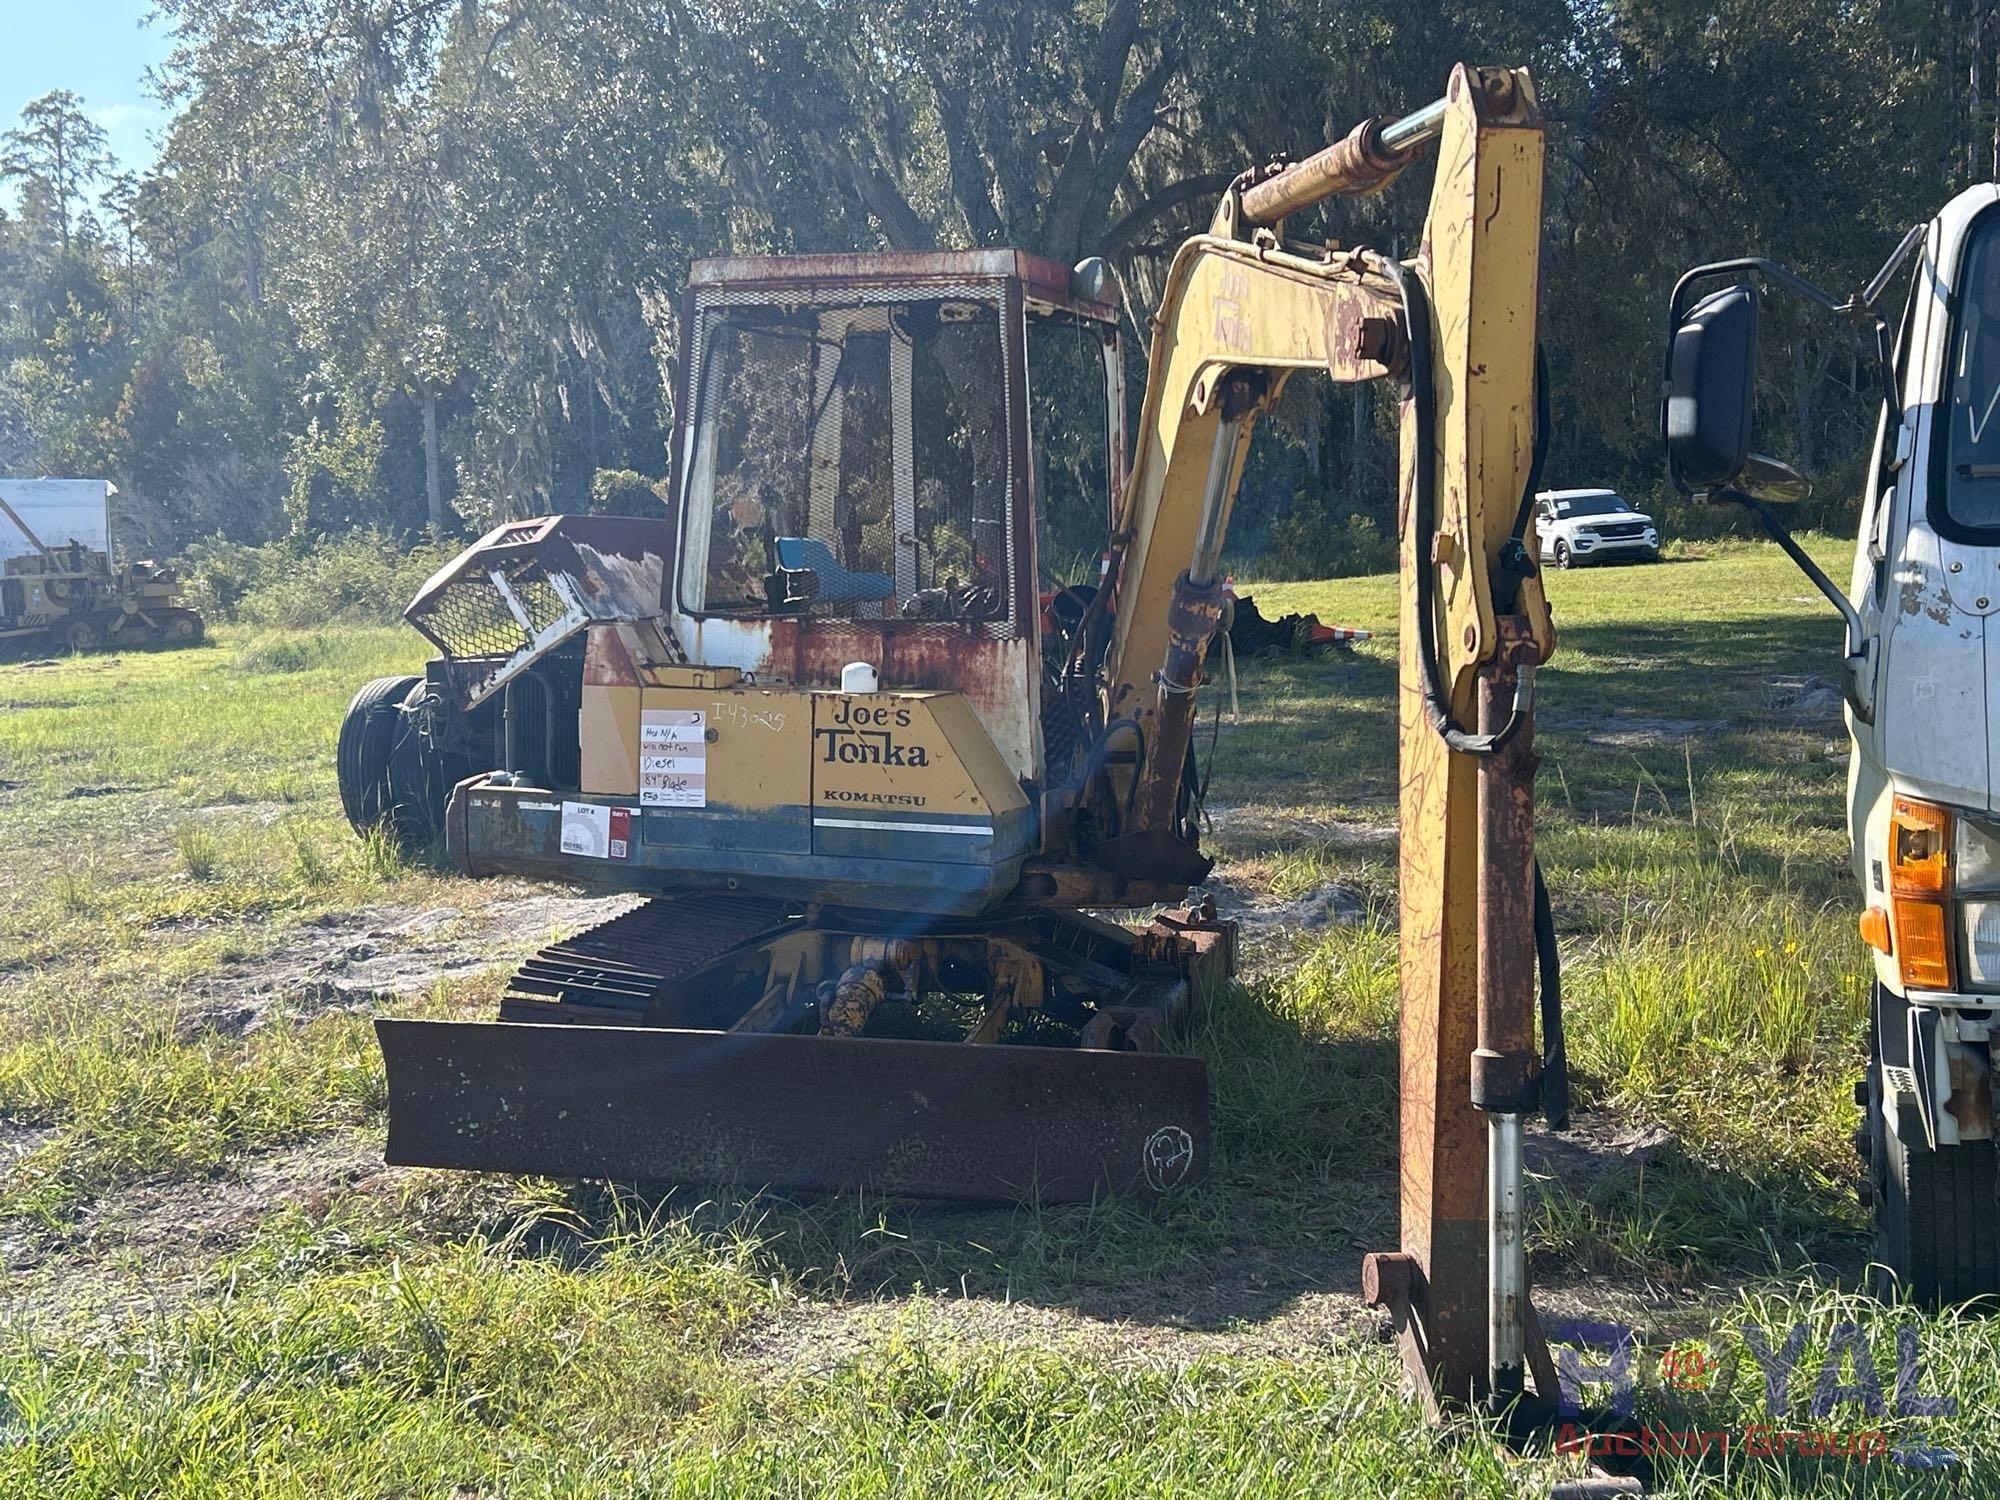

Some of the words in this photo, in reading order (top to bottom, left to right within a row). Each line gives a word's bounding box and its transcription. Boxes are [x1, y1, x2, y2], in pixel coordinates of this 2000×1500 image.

[690, 712, 701, 724] 3
[658, 743, 673, 752] not
[815, 728, 930, 767] Tonka
[643, 757, 676, 771] Diesel
[823, 790, 926, 807] KOMATSU
[577, 806, 590, 814] LOT
